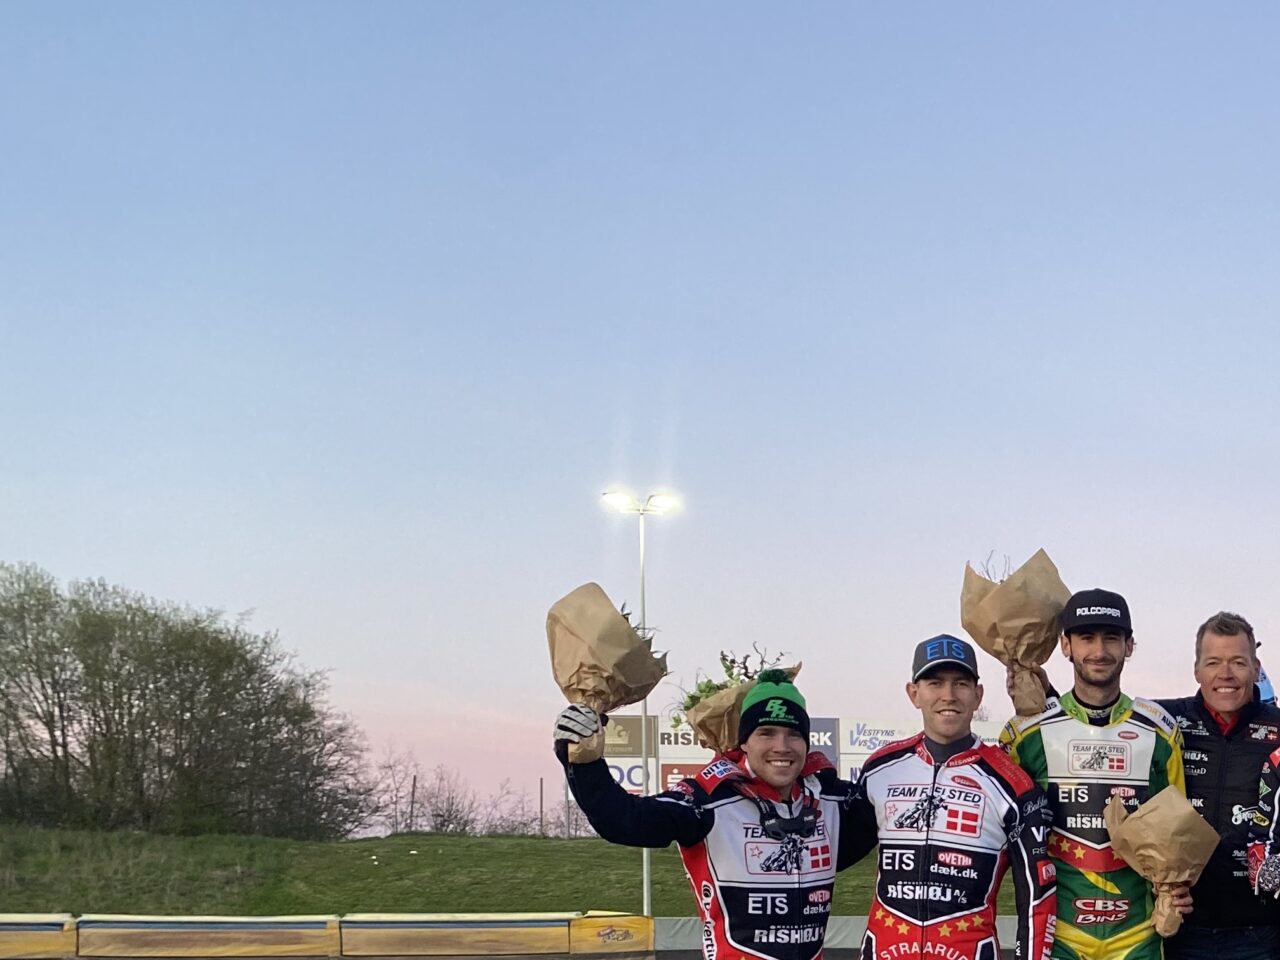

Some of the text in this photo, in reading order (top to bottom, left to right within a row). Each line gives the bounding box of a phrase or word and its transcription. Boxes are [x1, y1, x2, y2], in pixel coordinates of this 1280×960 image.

[926, 639, 966, 660] ETS
[856, 723, 895, 737] VESTFYNS
[887, 787, 917, 798] TEAM
[1058, 786, 1089, 803] ETS
[882, 850, 915, 871] ETS
[930, 863, 978, 879] dæk.dk
[748, 893, 789, 915] ETS
[1075, 899, 1129, 911] CBS
[1076, 912, 1127, 924] BINS
